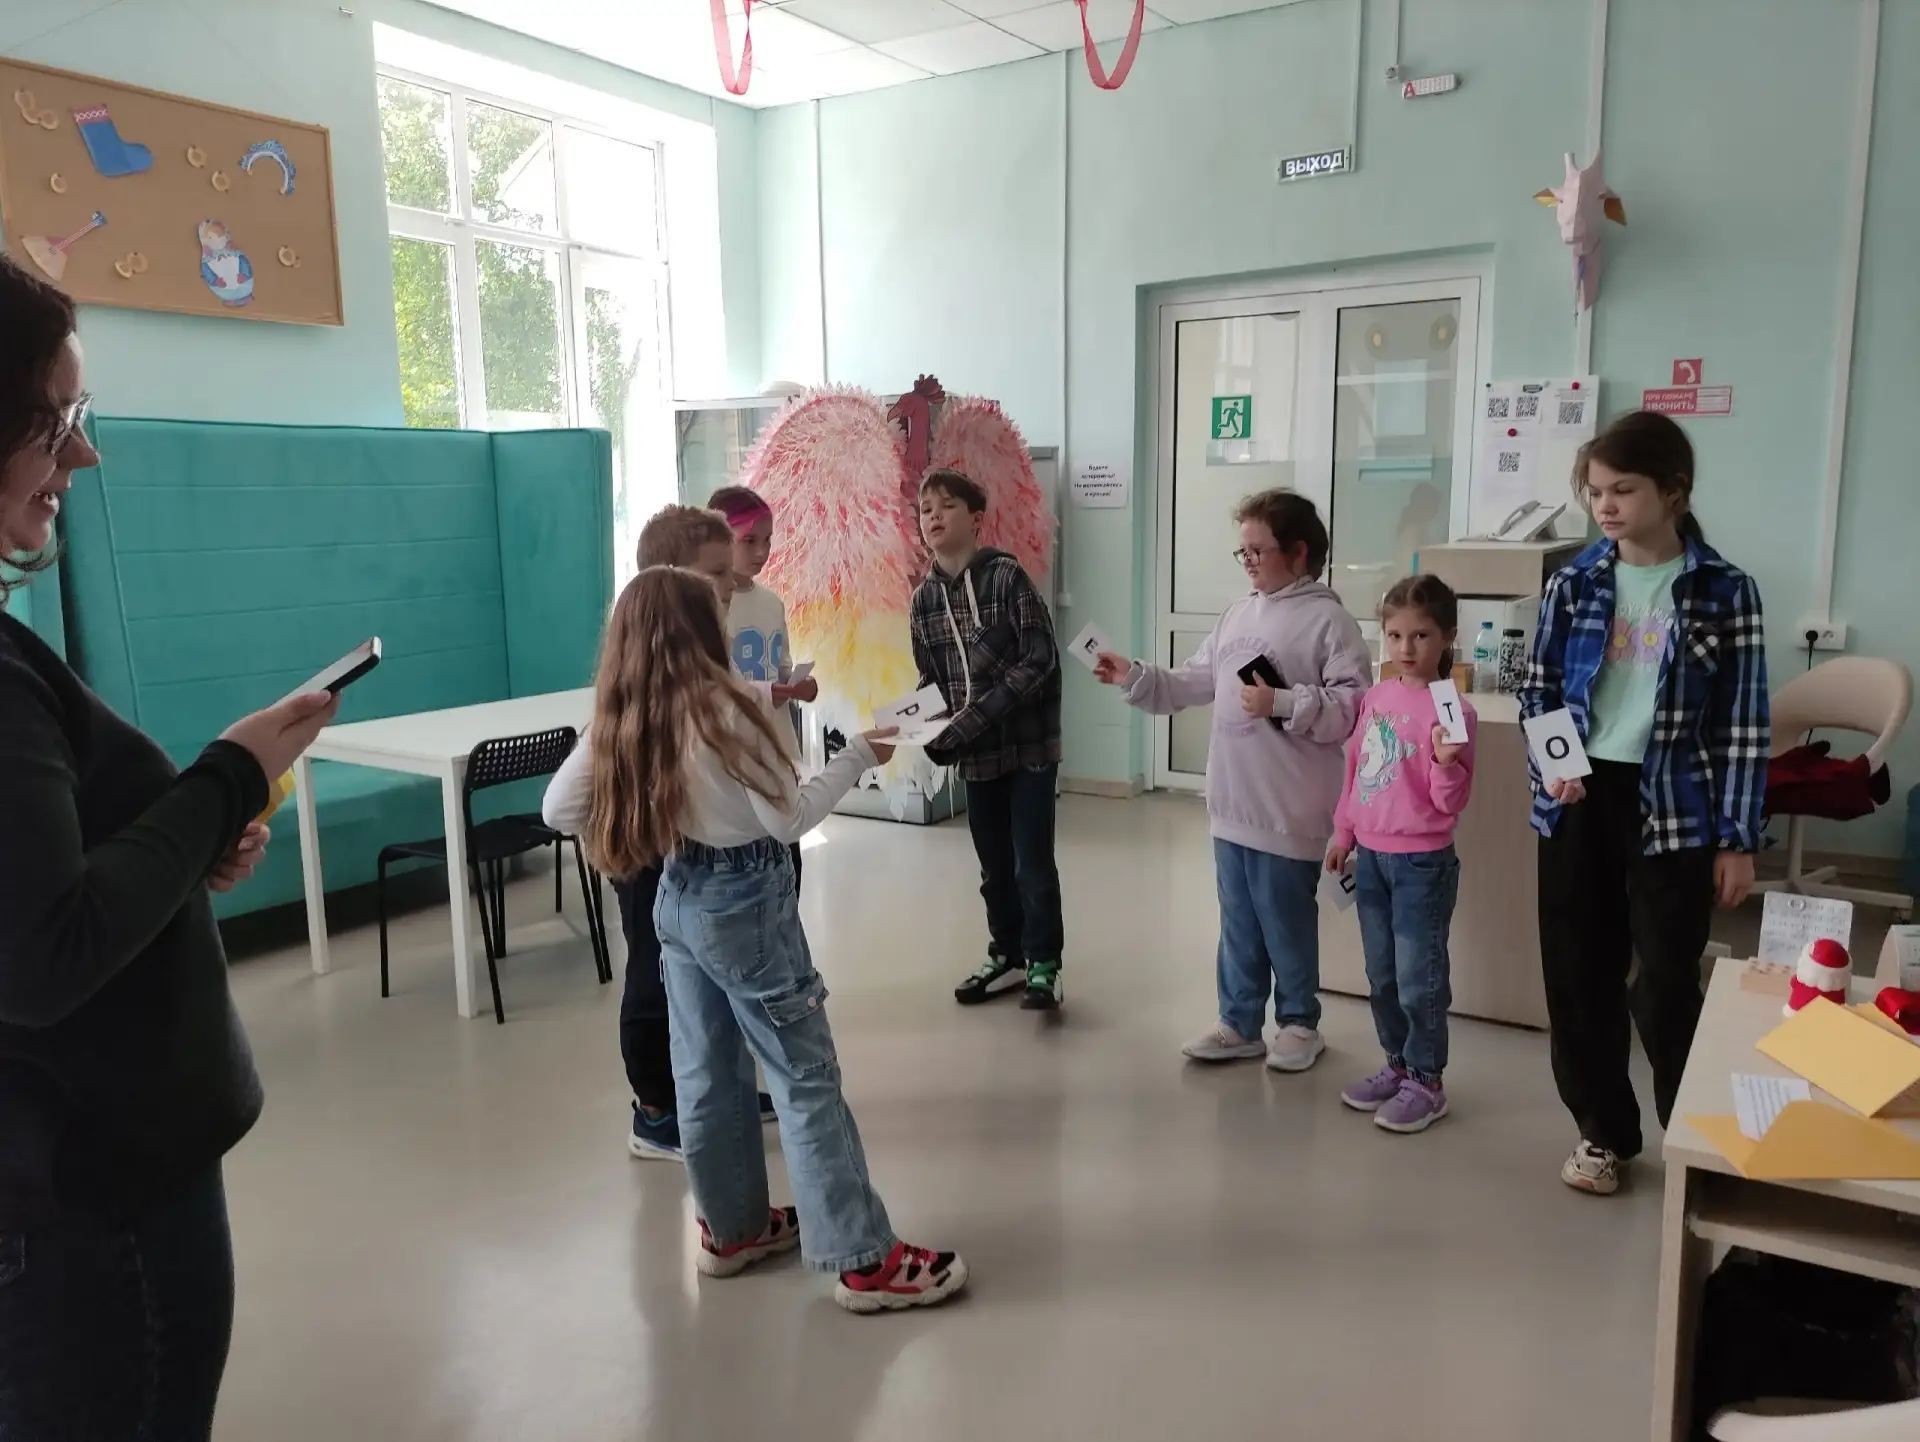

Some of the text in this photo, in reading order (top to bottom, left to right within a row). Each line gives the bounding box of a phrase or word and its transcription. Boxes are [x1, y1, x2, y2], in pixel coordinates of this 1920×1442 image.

[1285, 153, 1342, 176] ВЫХОД
[1662, 391, 1695, 401] ПОЖАРЕ
[1645, 401, 1695, 411] ЗВОНИТЬ
[896, 703, 920, 716] Р
[1442, 702, 1453, 723] Т
[1545, 735, 1570, 760] О
